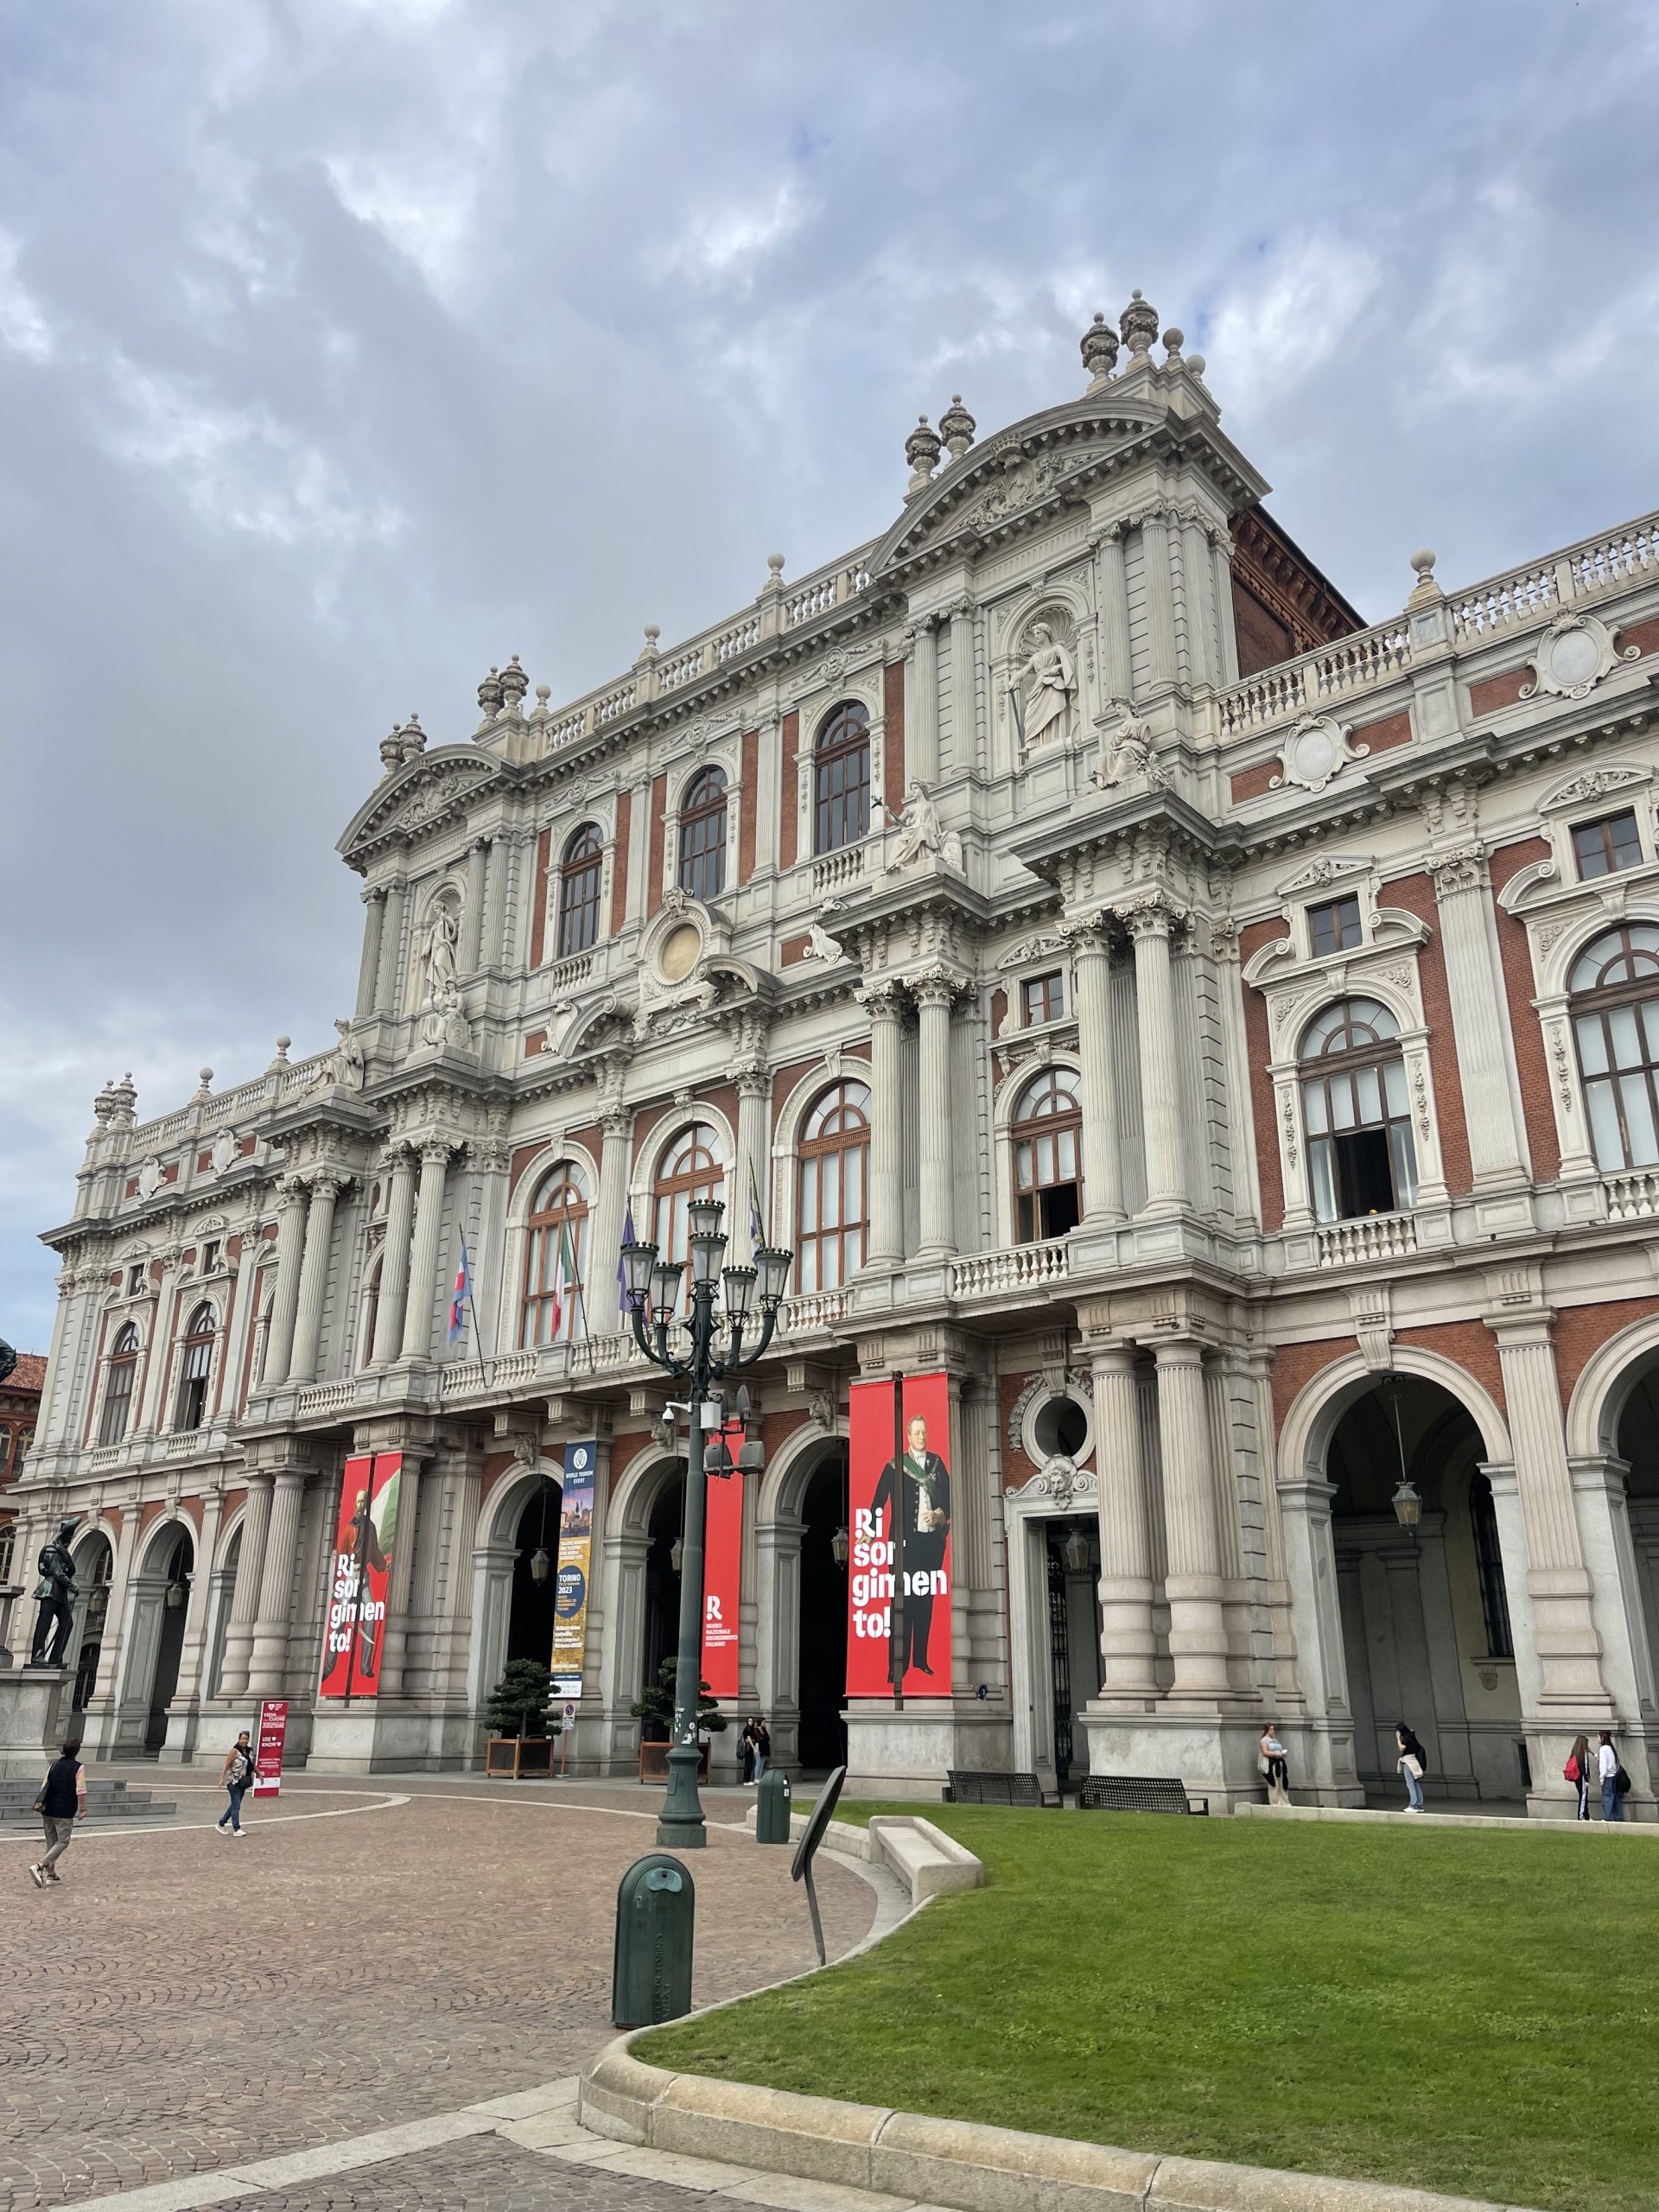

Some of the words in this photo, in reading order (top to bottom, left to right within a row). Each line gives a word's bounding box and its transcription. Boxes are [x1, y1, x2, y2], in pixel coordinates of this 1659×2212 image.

[855, 1507, 883, 1539] Ri
[336, 1553, 355, 1578] Ri
[557, 1586, 573, 1594] 2023
[558, 1573, 582, 1583] TORINO
[853, 1606, 891, 1638] to!
[329, 1628, 352, 1652] to!
